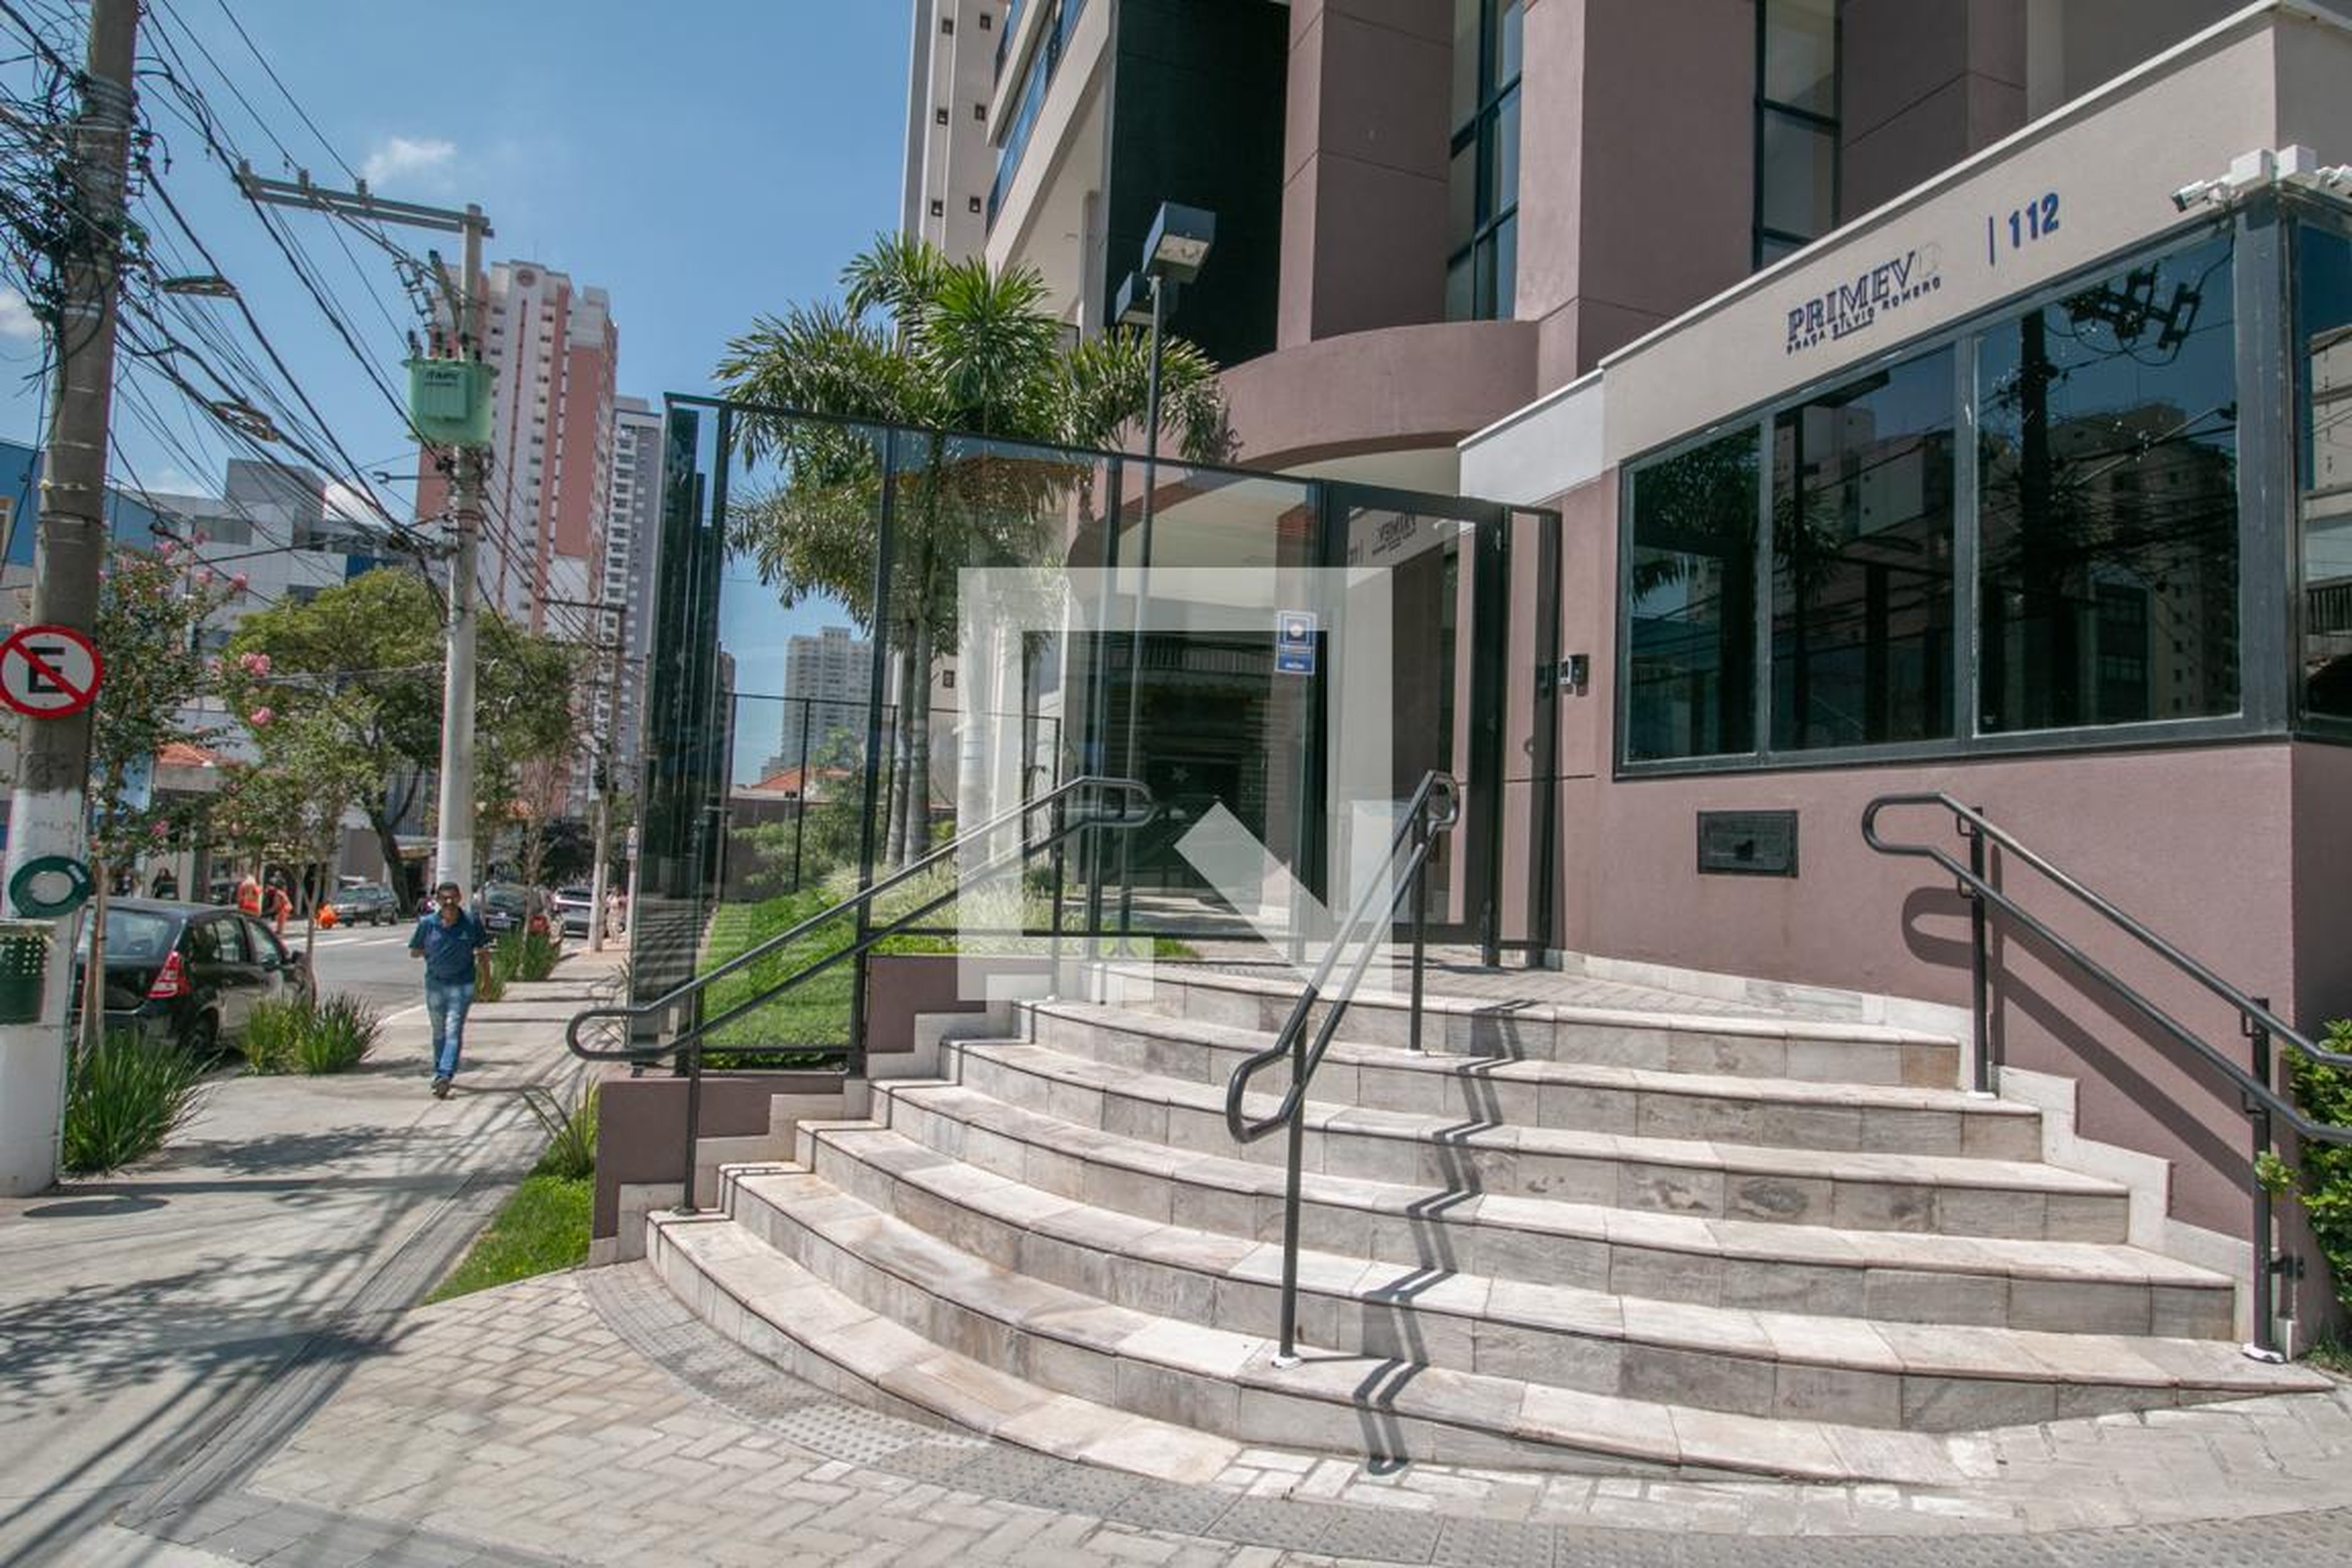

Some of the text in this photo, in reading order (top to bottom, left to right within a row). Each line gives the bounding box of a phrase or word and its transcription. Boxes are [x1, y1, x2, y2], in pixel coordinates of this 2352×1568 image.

[2008, 193, 2060, 249] 112
[1787, 330, 1826, 355] PRAÇA
[1882, 276, 1940, 310] ROMERO
[29, 647, 66, 693] E
